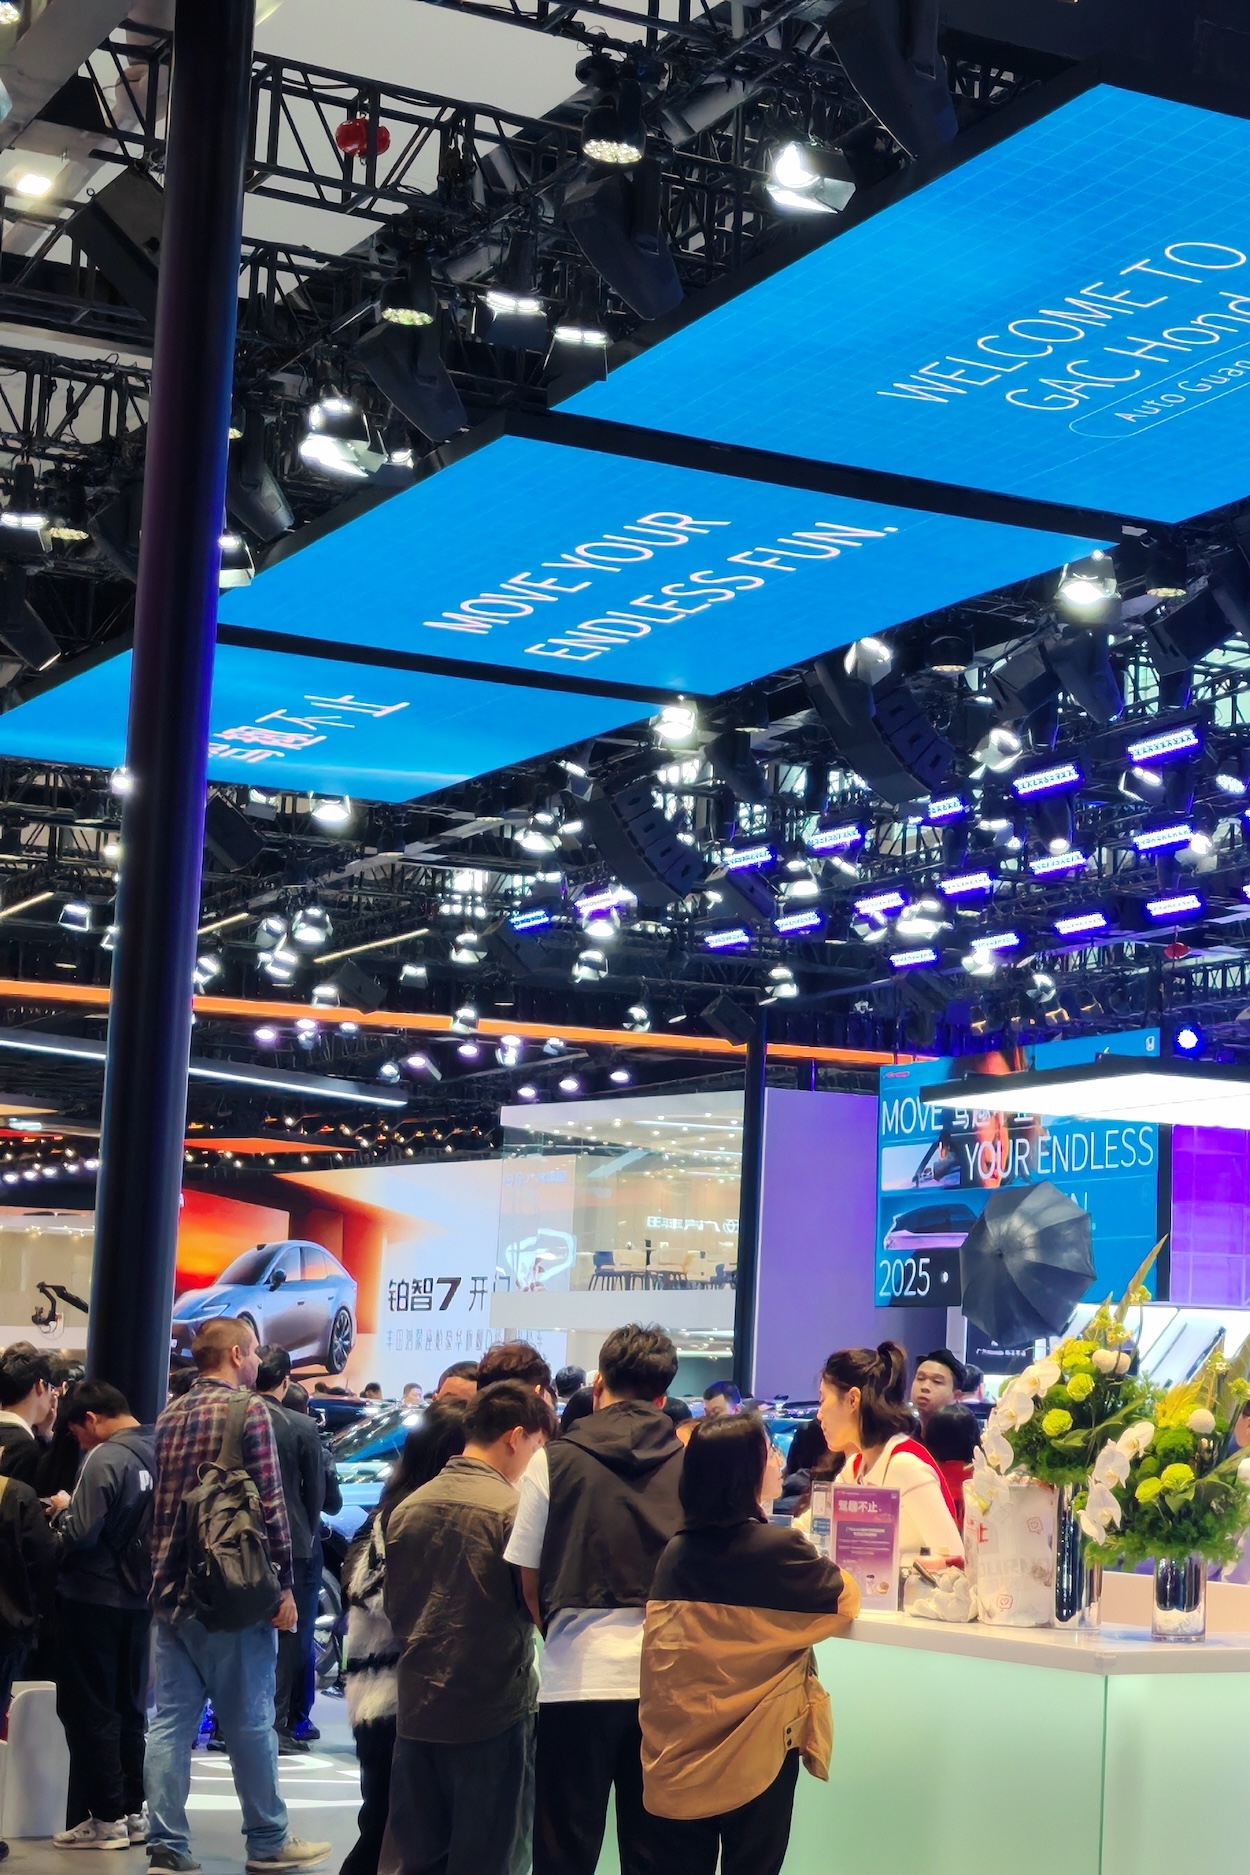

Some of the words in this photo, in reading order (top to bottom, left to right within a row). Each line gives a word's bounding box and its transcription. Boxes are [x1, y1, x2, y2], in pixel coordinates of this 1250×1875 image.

[877, 282, 1168, 403] WELCOME
[1120, 241, 1247, 284] TO
[1005, 359, 1141, 411] GAC
[1113, 391, 1187, 423] Auto
[423, 571, 592, 634] MOVE
[541, 511, 731, 573] YOUR
[524, 569, 765, 661] ENDLESS
[727, 521, 899, 572] FUN.
[881, 1096, 944, 1136] MOVE
[964, 1136, 1032, 1181] YOUR
[1036, 1126, 1154, 1175] ENDLESS
[387, 1276, 462, 1312] 铂智7
[878, 1257, 931, 1297] 2025
